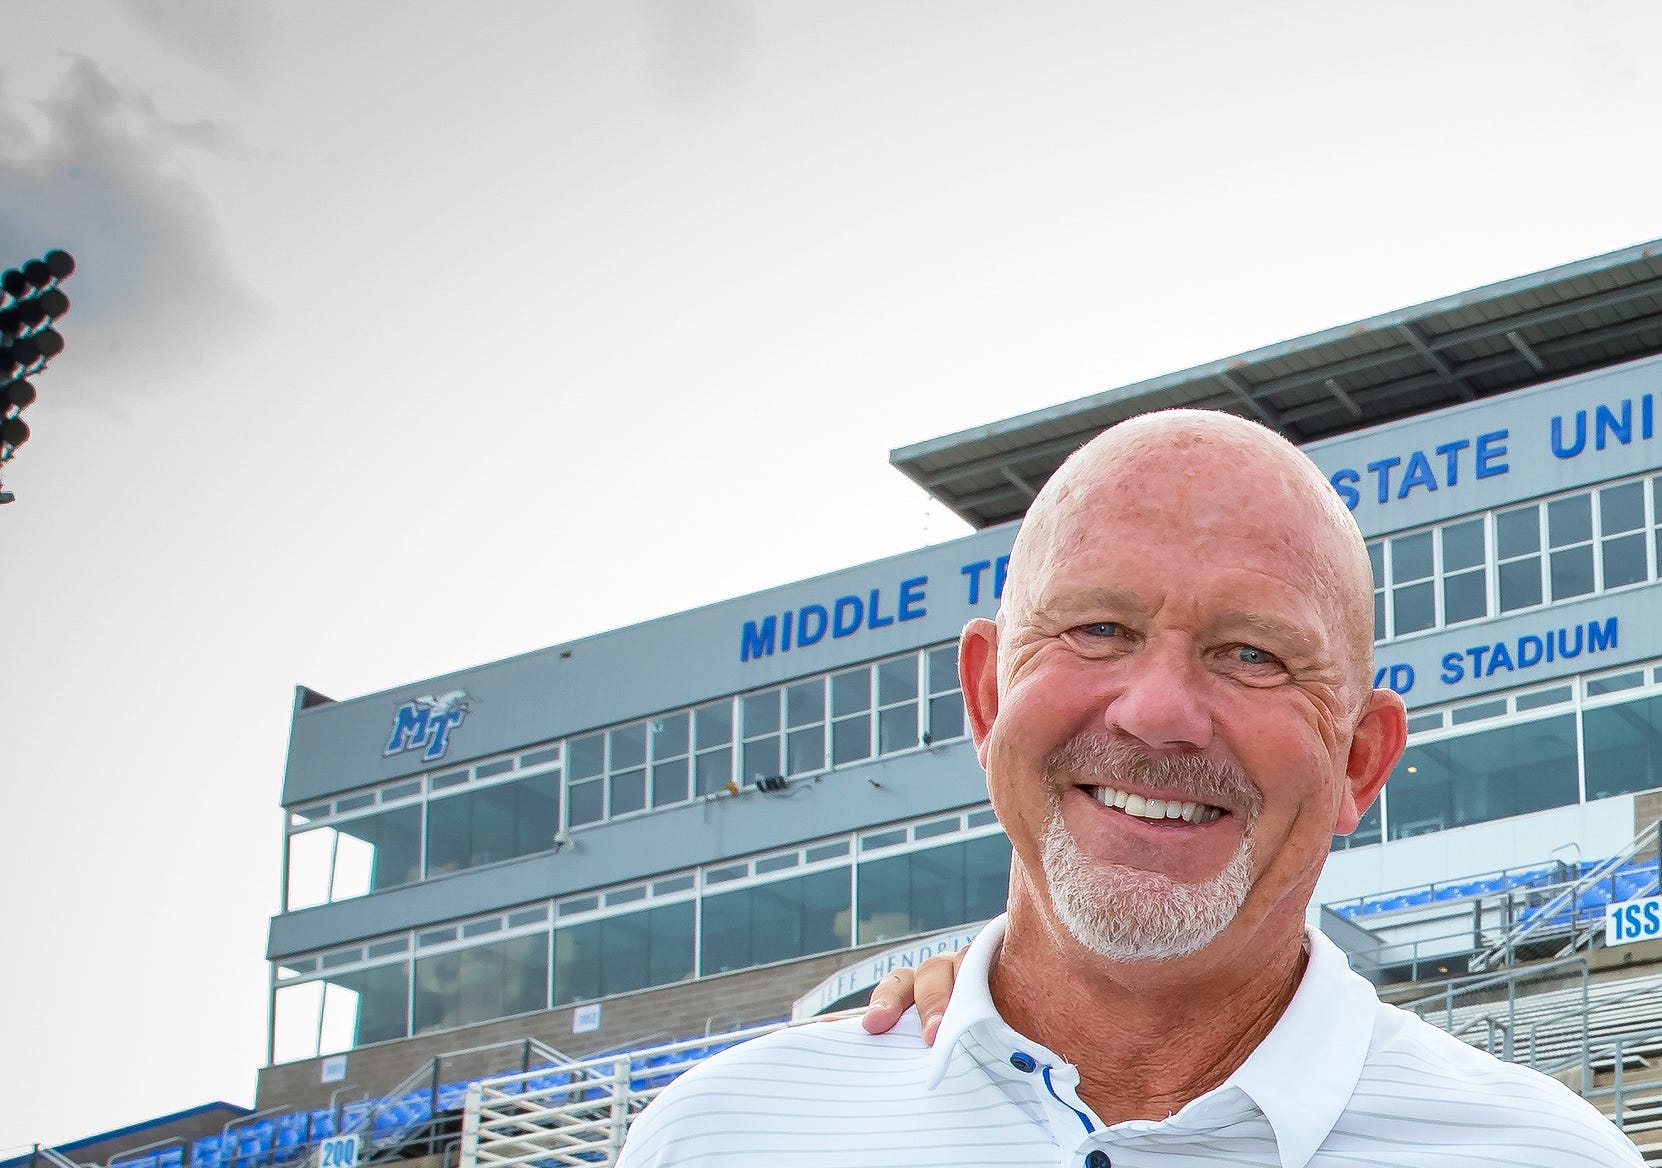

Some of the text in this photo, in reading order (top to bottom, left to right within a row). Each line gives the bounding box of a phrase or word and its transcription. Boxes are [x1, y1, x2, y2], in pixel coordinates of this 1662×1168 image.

[740, 575, 928, 662] MIDDLE
[1330, 428, 1509, 511] STATE
[1440, 616, 1618, 685] STADIUM
[381, 702, 467, 763] MT
[1612, 901, 1660, 940] 1SS
[322, 1139, 354, 1167] 200
